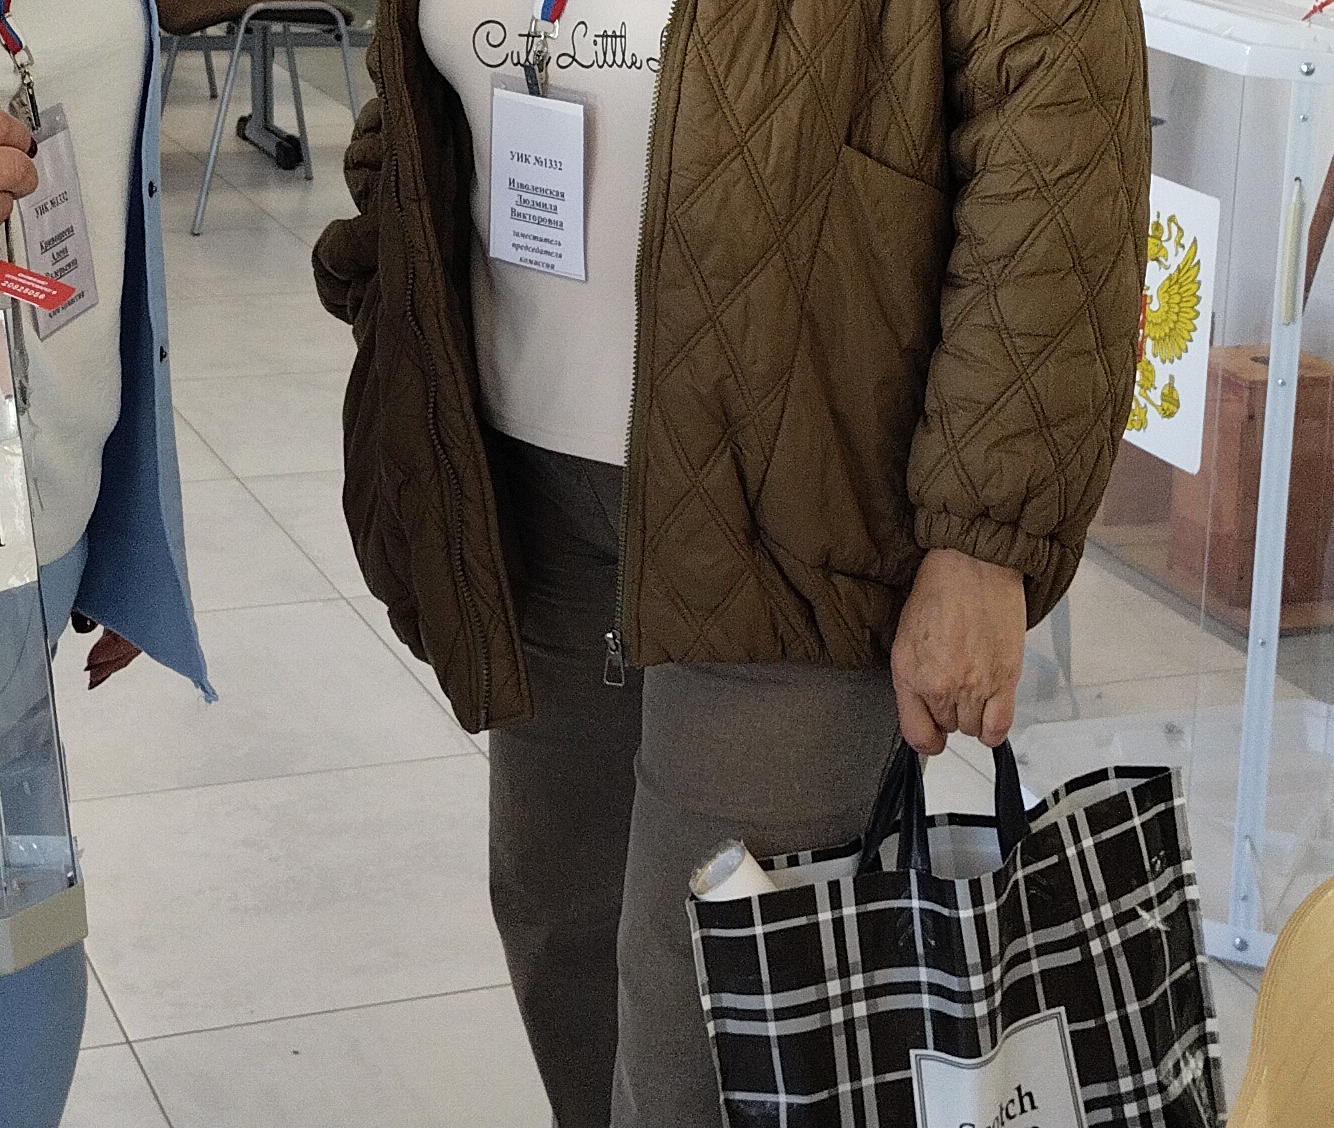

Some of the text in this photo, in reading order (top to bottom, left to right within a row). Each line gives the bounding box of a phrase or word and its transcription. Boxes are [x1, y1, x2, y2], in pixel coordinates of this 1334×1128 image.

[472, 20, 551, 69] Cut
[556, 21, 643, 71] Little
[510, 151, 563, 171] УИК №1332
[508, 177, 565, 200] Изволенская
[515, 194, 558, 213] Людмила
[510, 207, 564, 229] Викторовна
[959, 1084, 1038, 1128] otch
